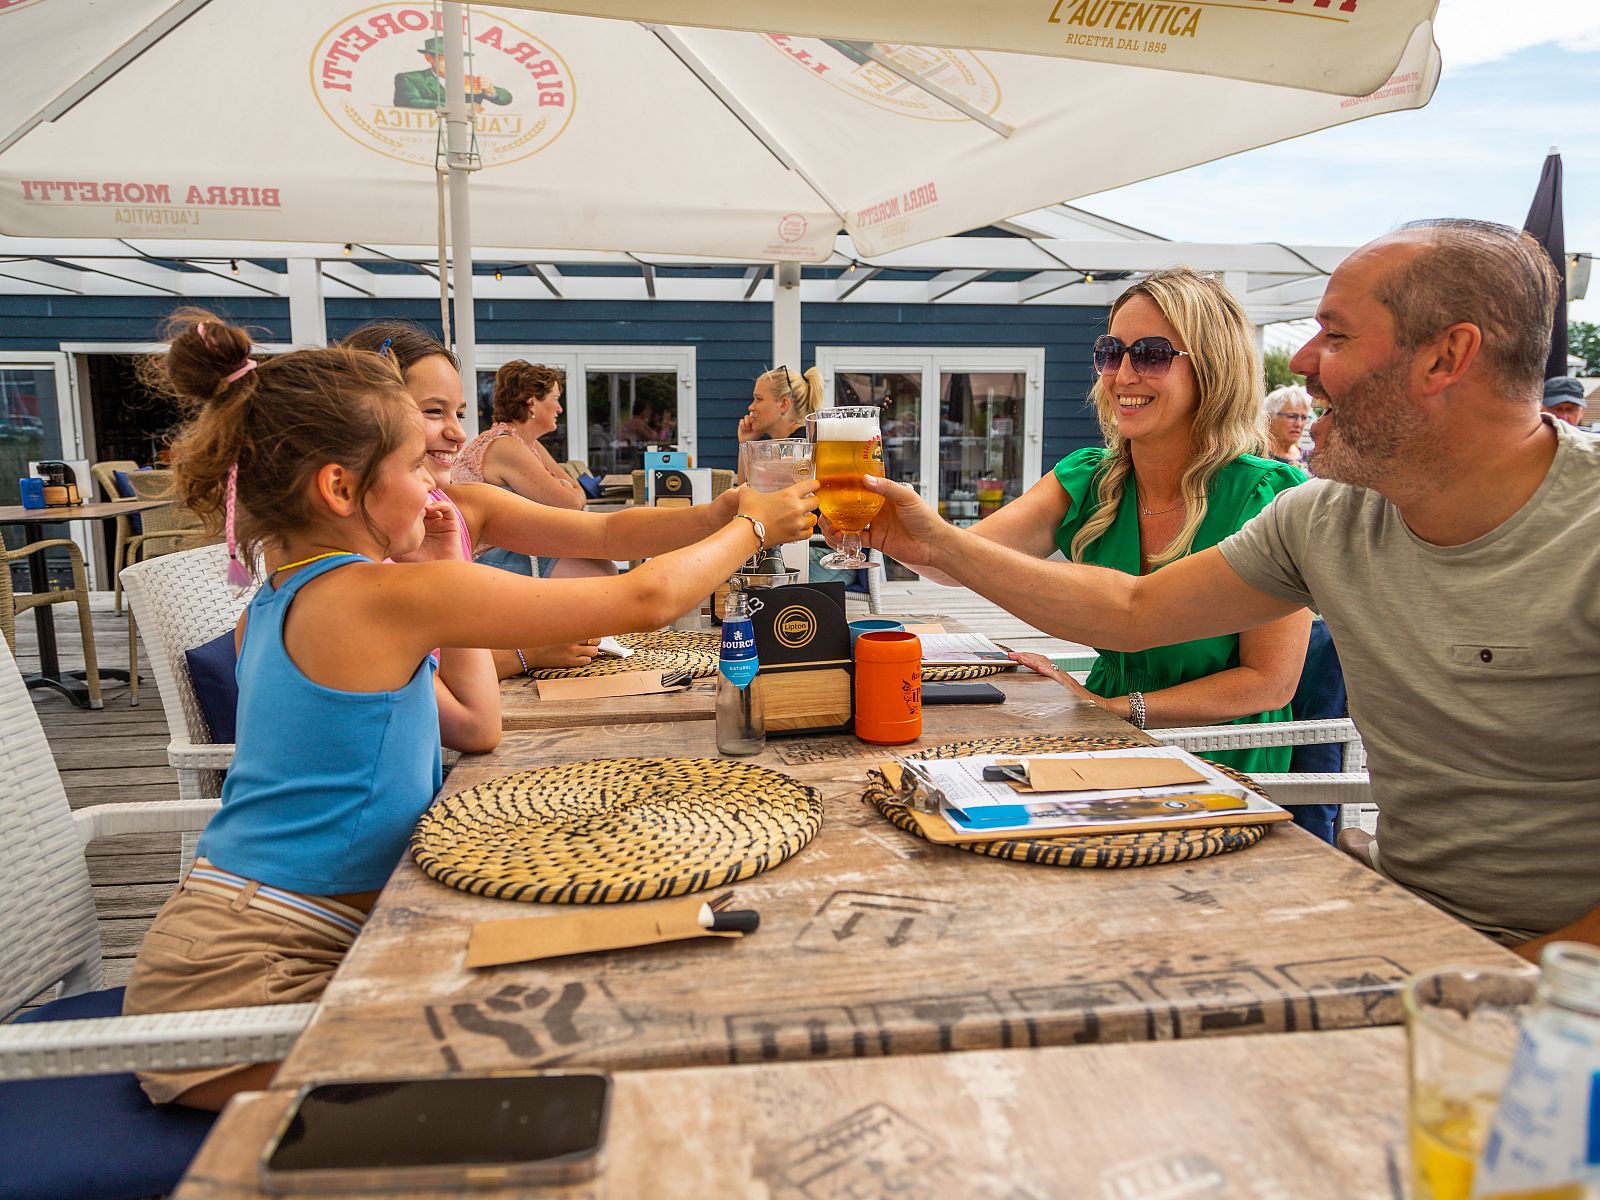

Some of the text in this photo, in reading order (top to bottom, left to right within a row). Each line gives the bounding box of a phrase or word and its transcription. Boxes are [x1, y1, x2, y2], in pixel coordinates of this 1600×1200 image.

[1047, 0, 1202, 38] L'AUTENTICA
[1066, 33, 1167, 54] RICETTA DAL 1859
[784, 623, 807, 631] Lipton
[722, 638, 754, 649] SOURCY
